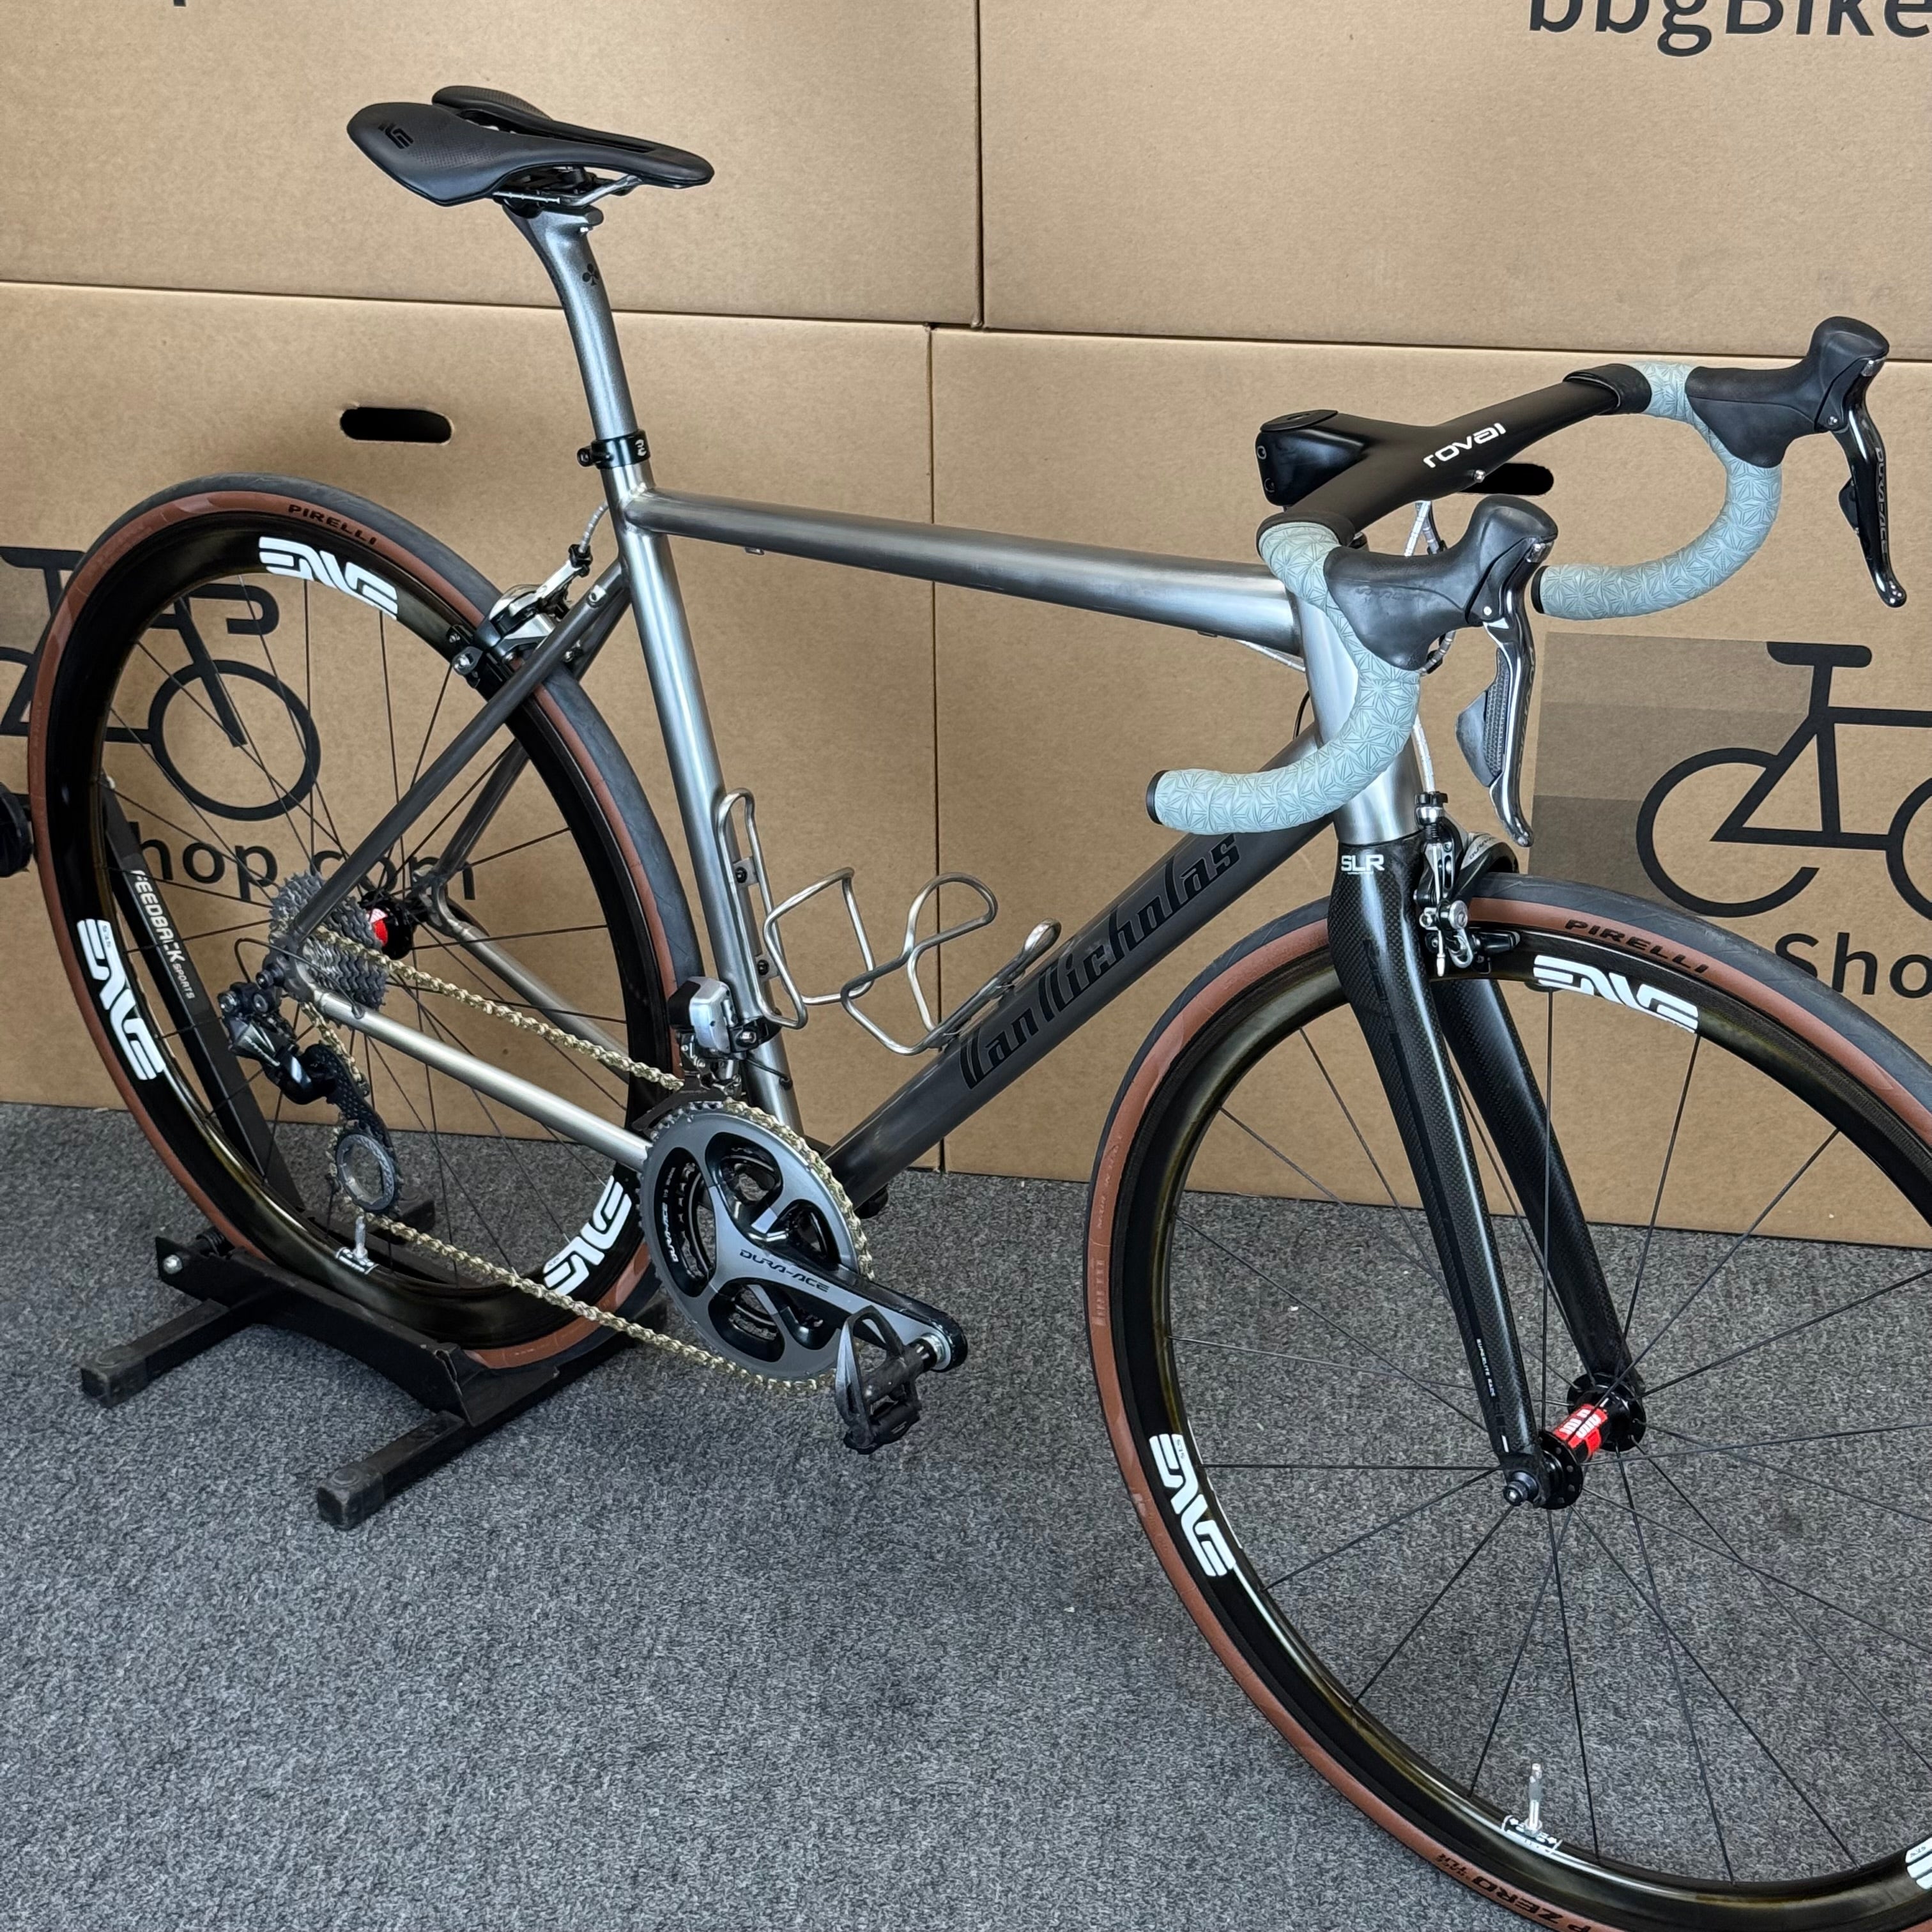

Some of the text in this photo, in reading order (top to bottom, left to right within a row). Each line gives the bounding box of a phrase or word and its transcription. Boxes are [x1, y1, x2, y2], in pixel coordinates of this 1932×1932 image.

[288, 503, 378, 546] PIRELLI
[258, 535, 399, 621] ENVE
[1341, 854, 1384, 871] SLR
[131, 869, 195, 1000] FEEDBACK SPORTS
[1565, 919, 1709, 974] PIRELLI
[77, 919, 165, 1080] ENVE
[662, 1202, 679, 1263] DURA-ACE
[739, 1249, 831, 1293] DURA-ACE
[1149, 1434, 1236, 1577] ENVE
[1471, 1875, 1563, 1924] ZERO
